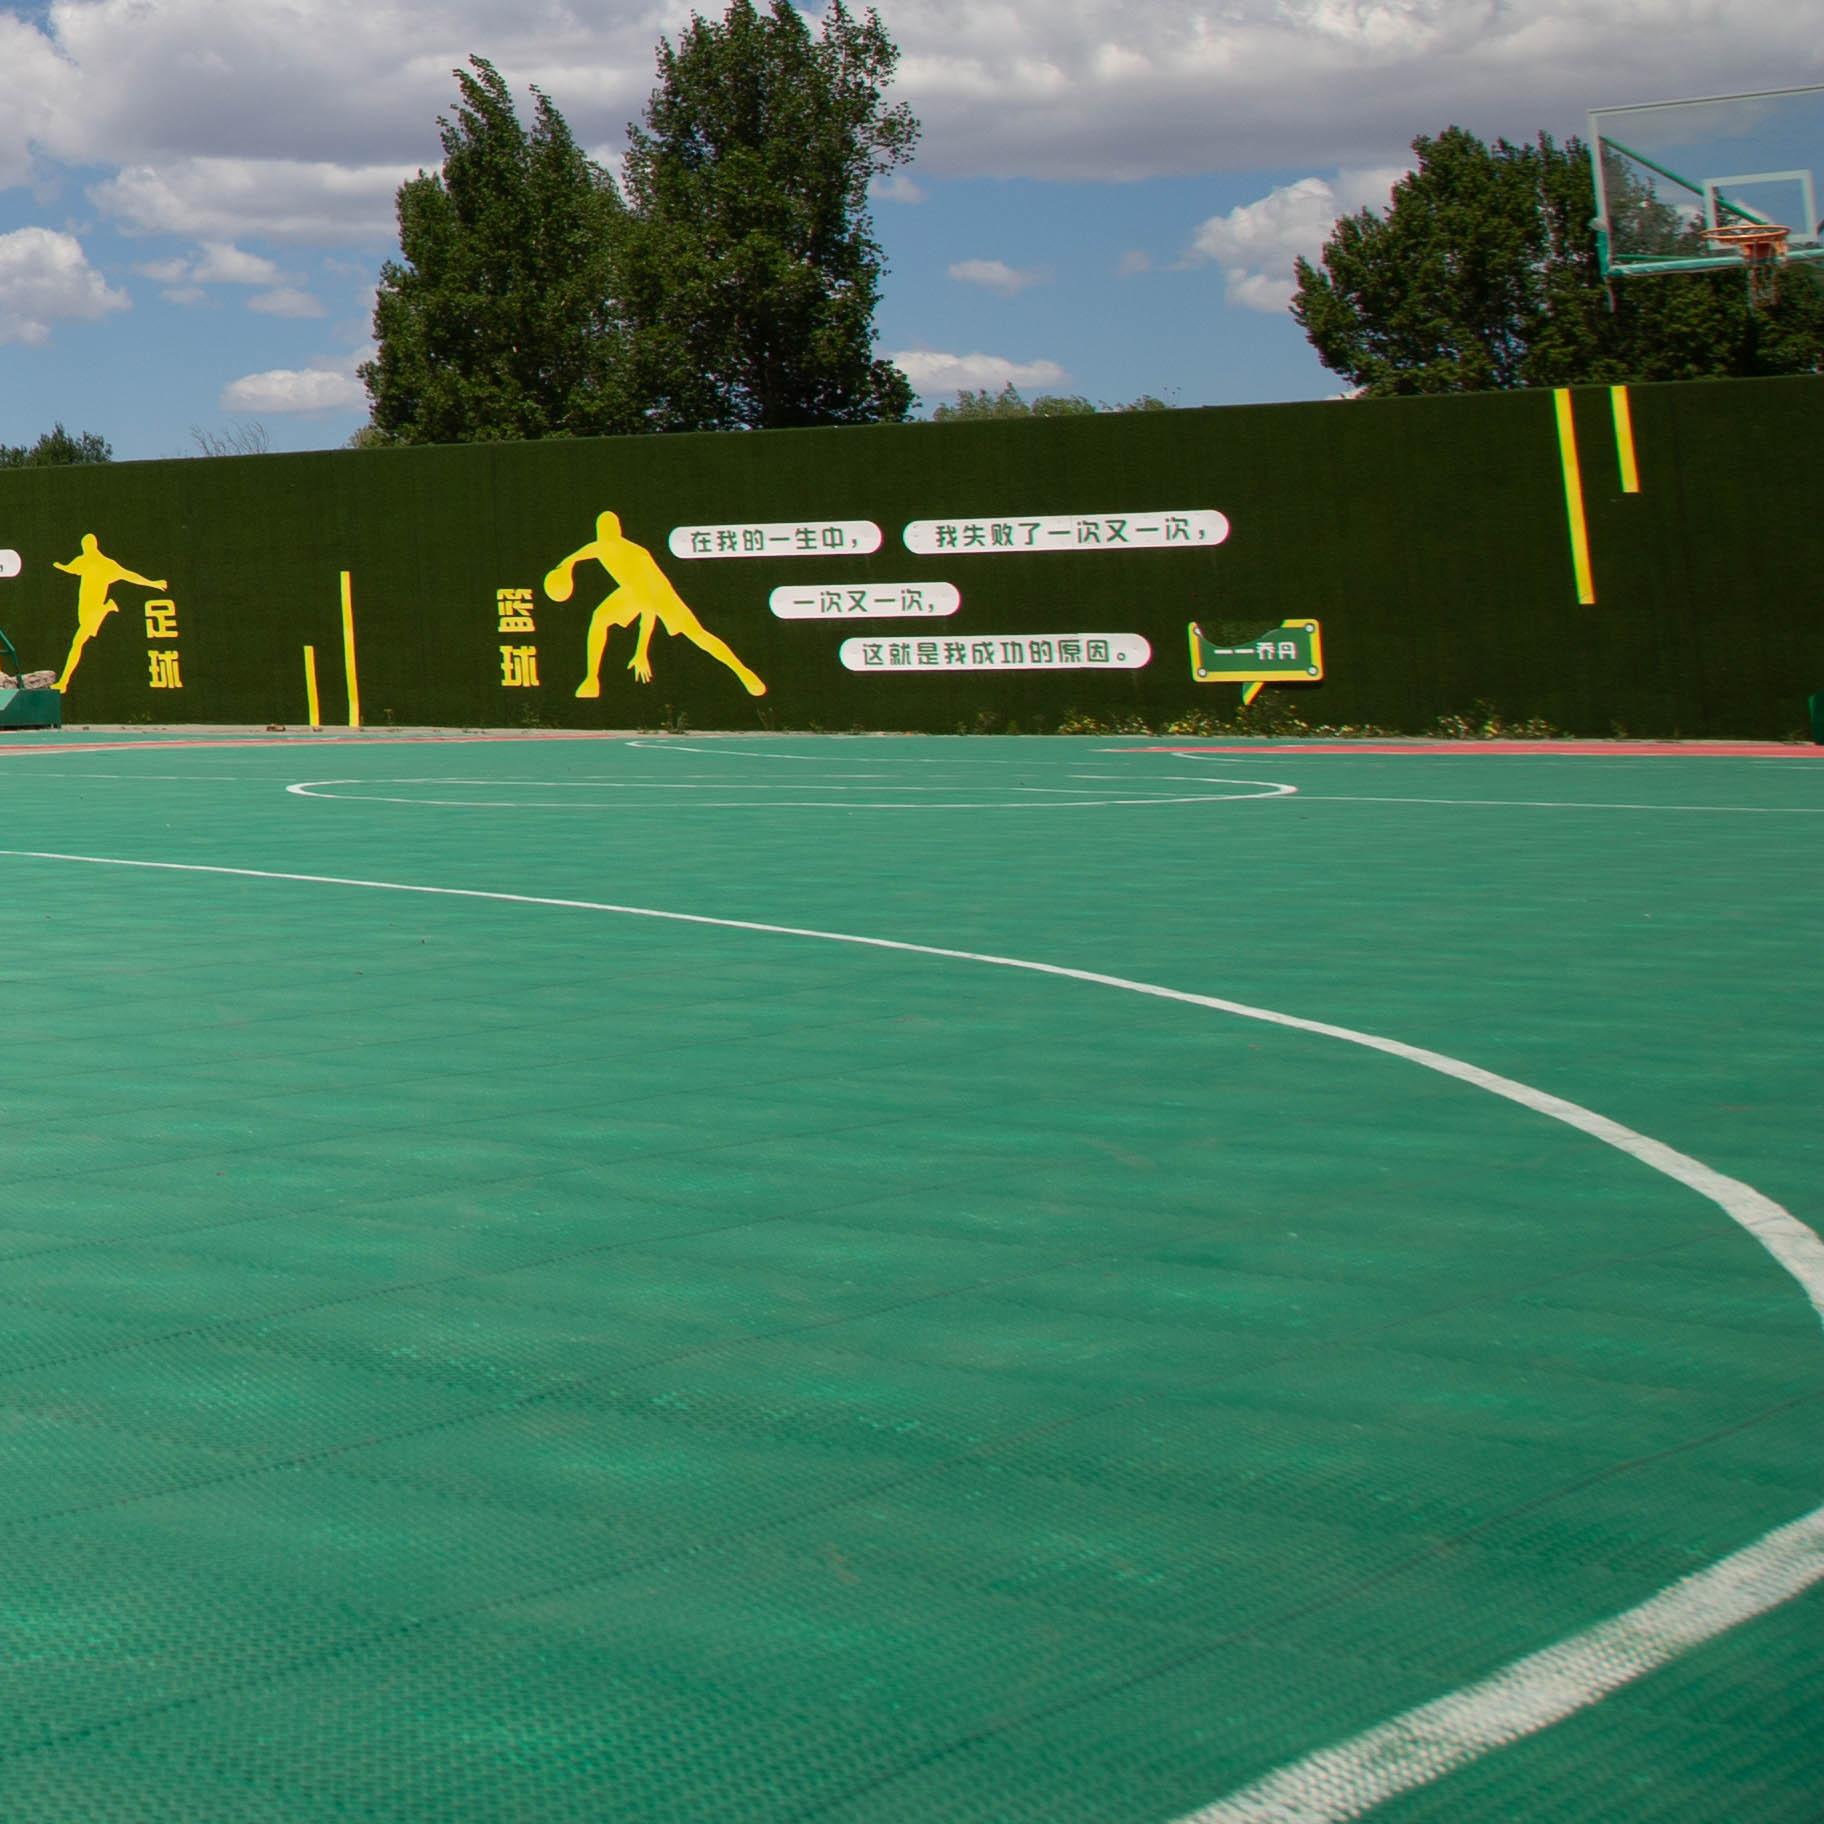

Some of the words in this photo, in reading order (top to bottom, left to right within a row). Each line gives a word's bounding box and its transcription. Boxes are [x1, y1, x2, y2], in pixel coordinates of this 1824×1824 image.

[690, 526, 859, 553] 在我的一生中，
[935, 516, 1207, 548] 我失败了一次又一次，
[793, 589, 935, 613] 一次又一次，
[145, 600, 184, 688] 足球
[497, 589, 540, 687] 篮球
[862, 638, 1127, 667] 这就是我成功的原因。
